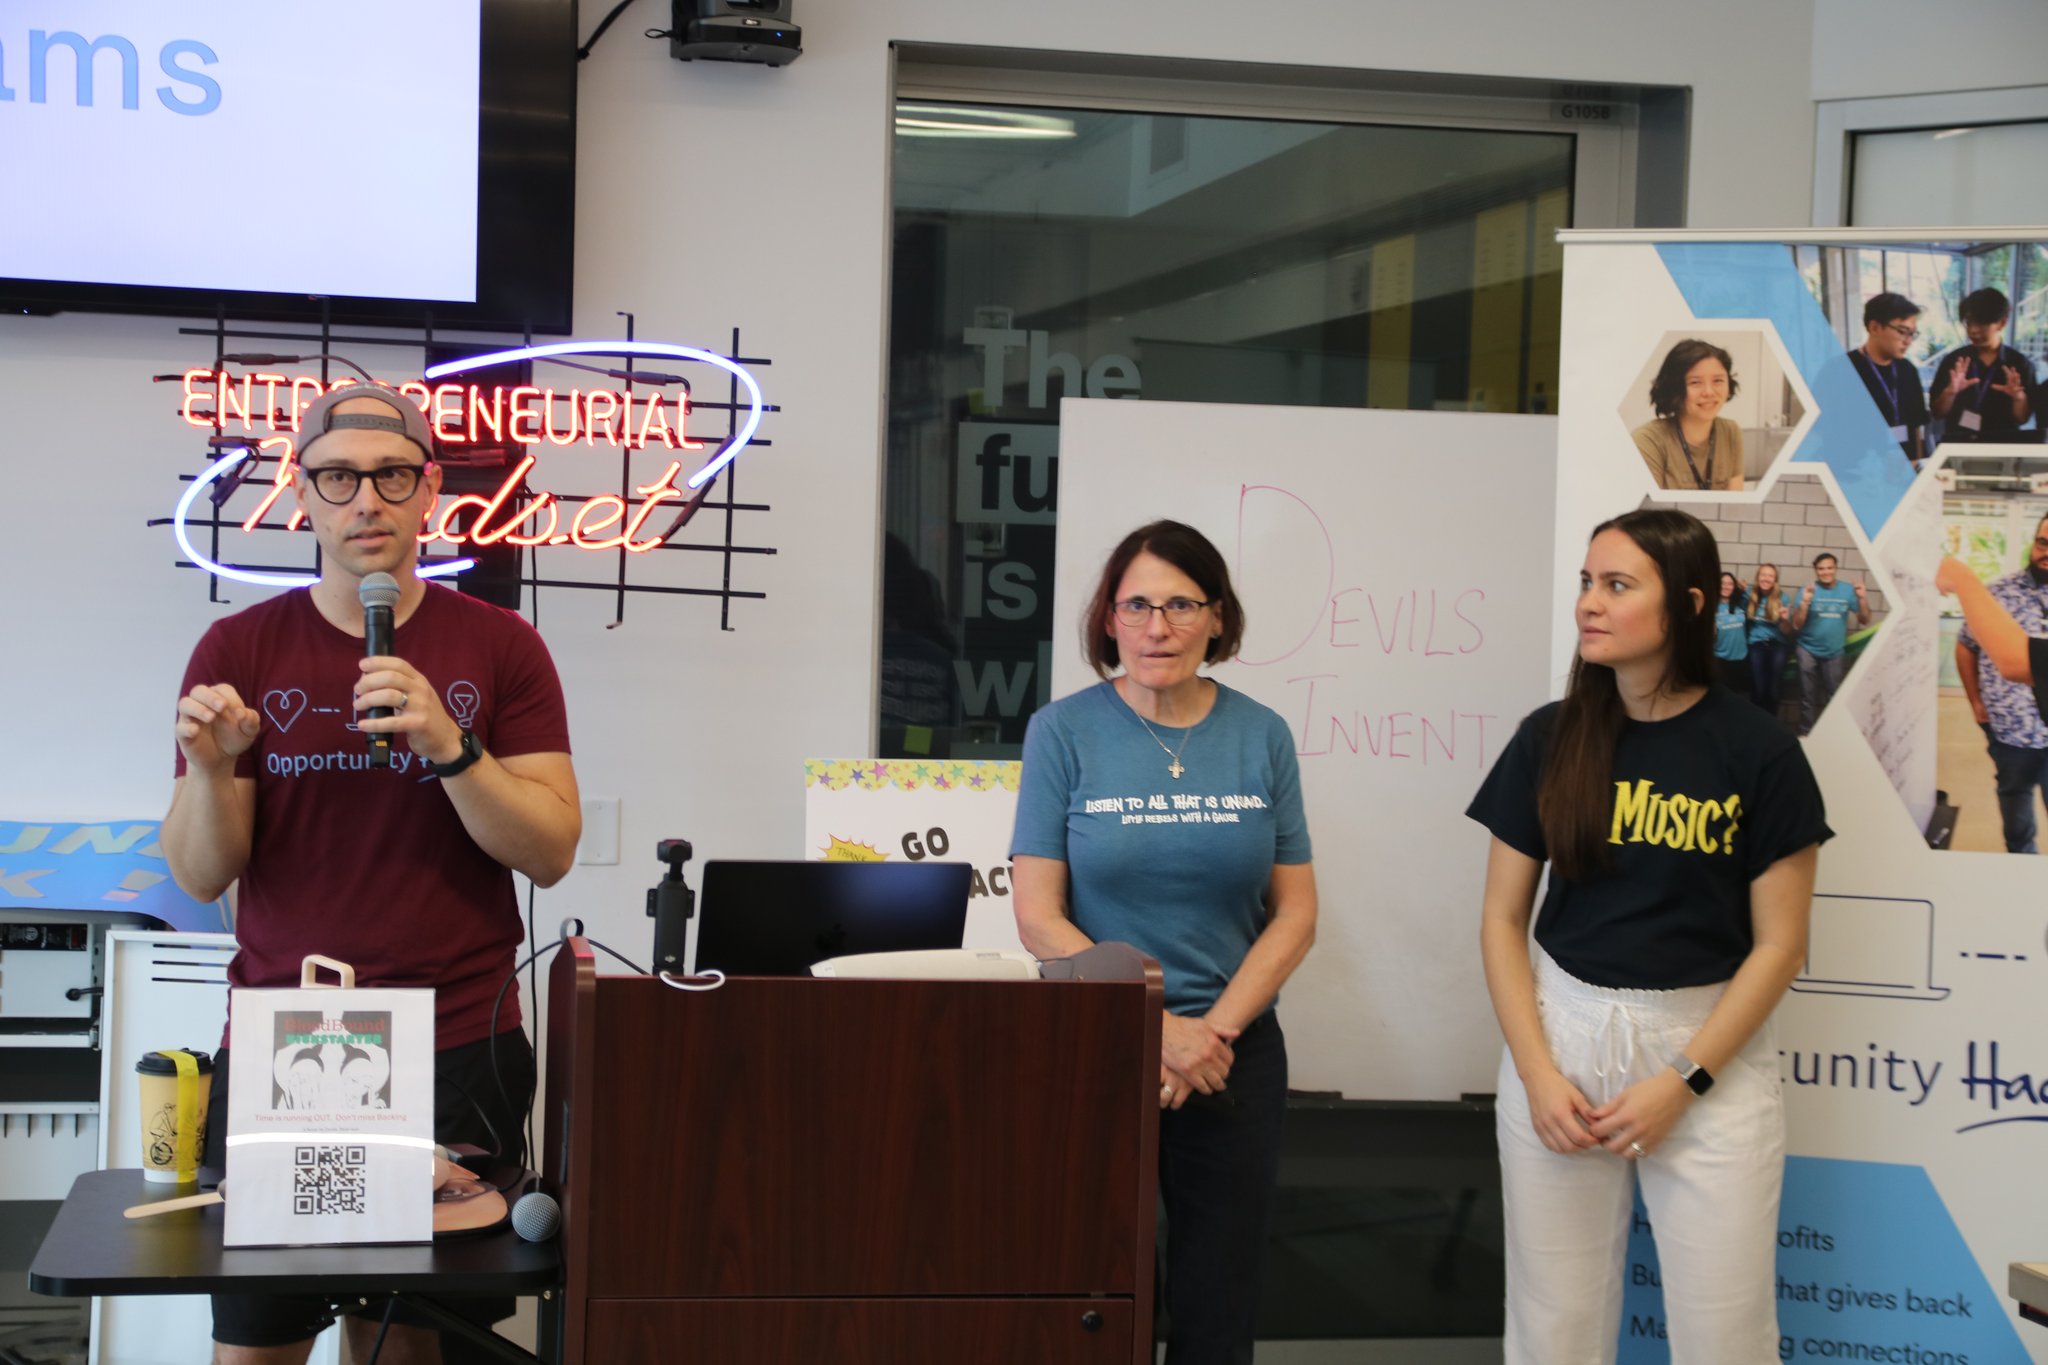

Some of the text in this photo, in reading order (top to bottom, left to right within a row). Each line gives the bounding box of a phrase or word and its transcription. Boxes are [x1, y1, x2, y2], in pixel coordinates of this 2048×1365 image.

[0, 29, 222, 117] ams
[963, 327, 1142, 408] The
[964, 540, 1038, 621] is
[1234, 483, 1486, 666] DEVILS
[1286, 674, 1498, 769] INVENT
[266, 750, 413, 778] Opportuty
[1085, 797, 1124, 814] LISTEN
[1126, 798, 1143, 810] TO
[1148, 794, 1168, 810] ALL
[1171, 793, 1202, 810] THAT
[1206, 797, 1218, 809] IS
[1180, 811, 1202, 824] WITH
[1606, 778, 1744, 856] MUSIC?
[901, 827, 950, 862] GO
[1779, 1043, 1942, 1106] unity
[1776, 1275, 1820, 1303] hat
[1826, 1283, 1899, 1314] gives
[1905, 1288, 1973, 1318] back
